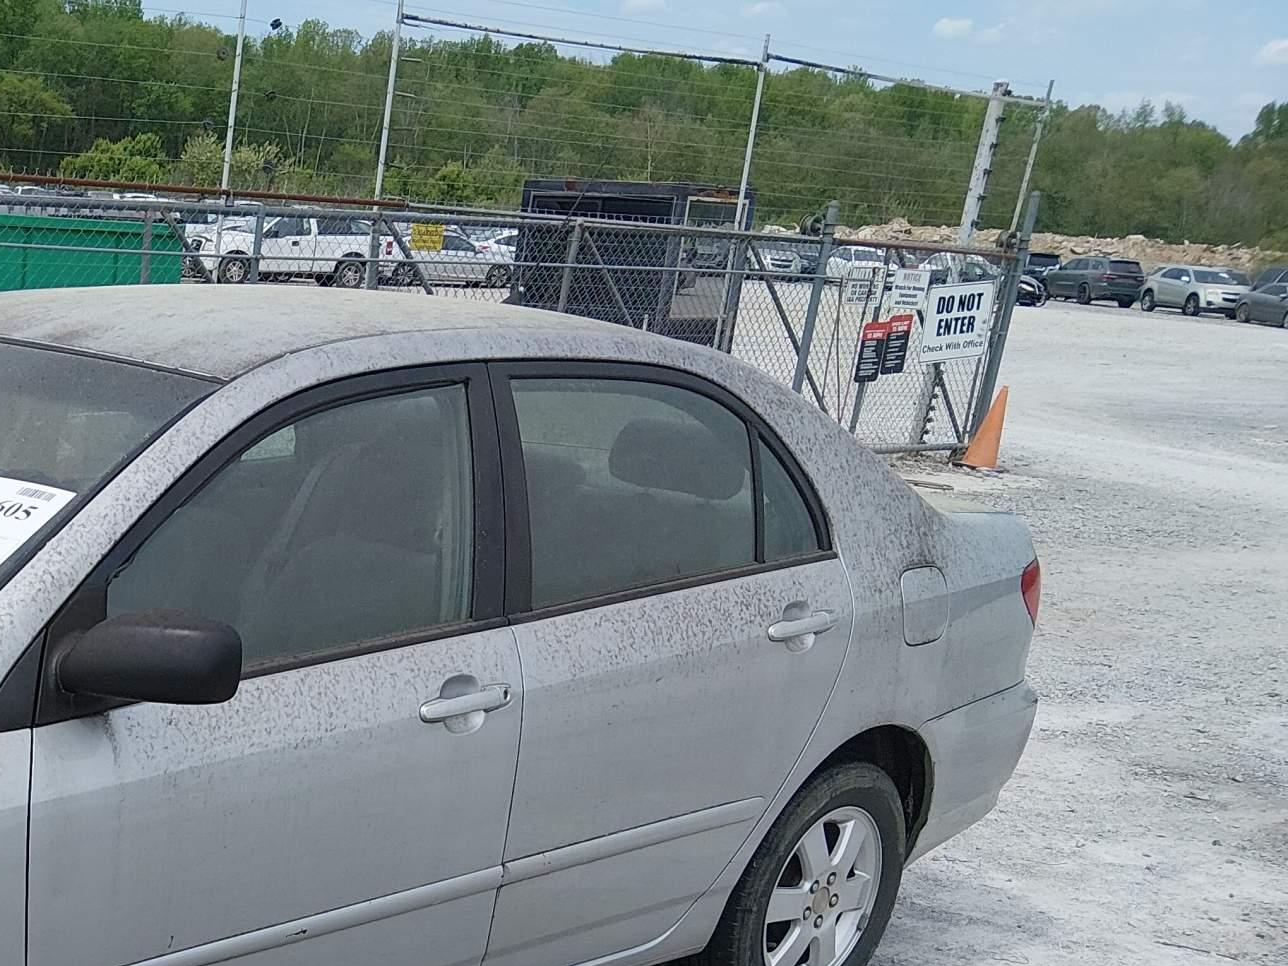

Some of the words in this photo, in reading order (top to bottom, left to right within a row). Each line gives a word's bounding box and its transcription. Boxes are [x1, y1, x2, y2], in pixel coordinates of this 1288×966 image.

[936, 295, 955, 315] DO
[957, 292, 984, 313] NOT
[936, 315, 976, 337] ENTER
[922, 343, 944, 354] Check
[945, 340, 961, 351] With
[962, 339, 984, 349] Office
